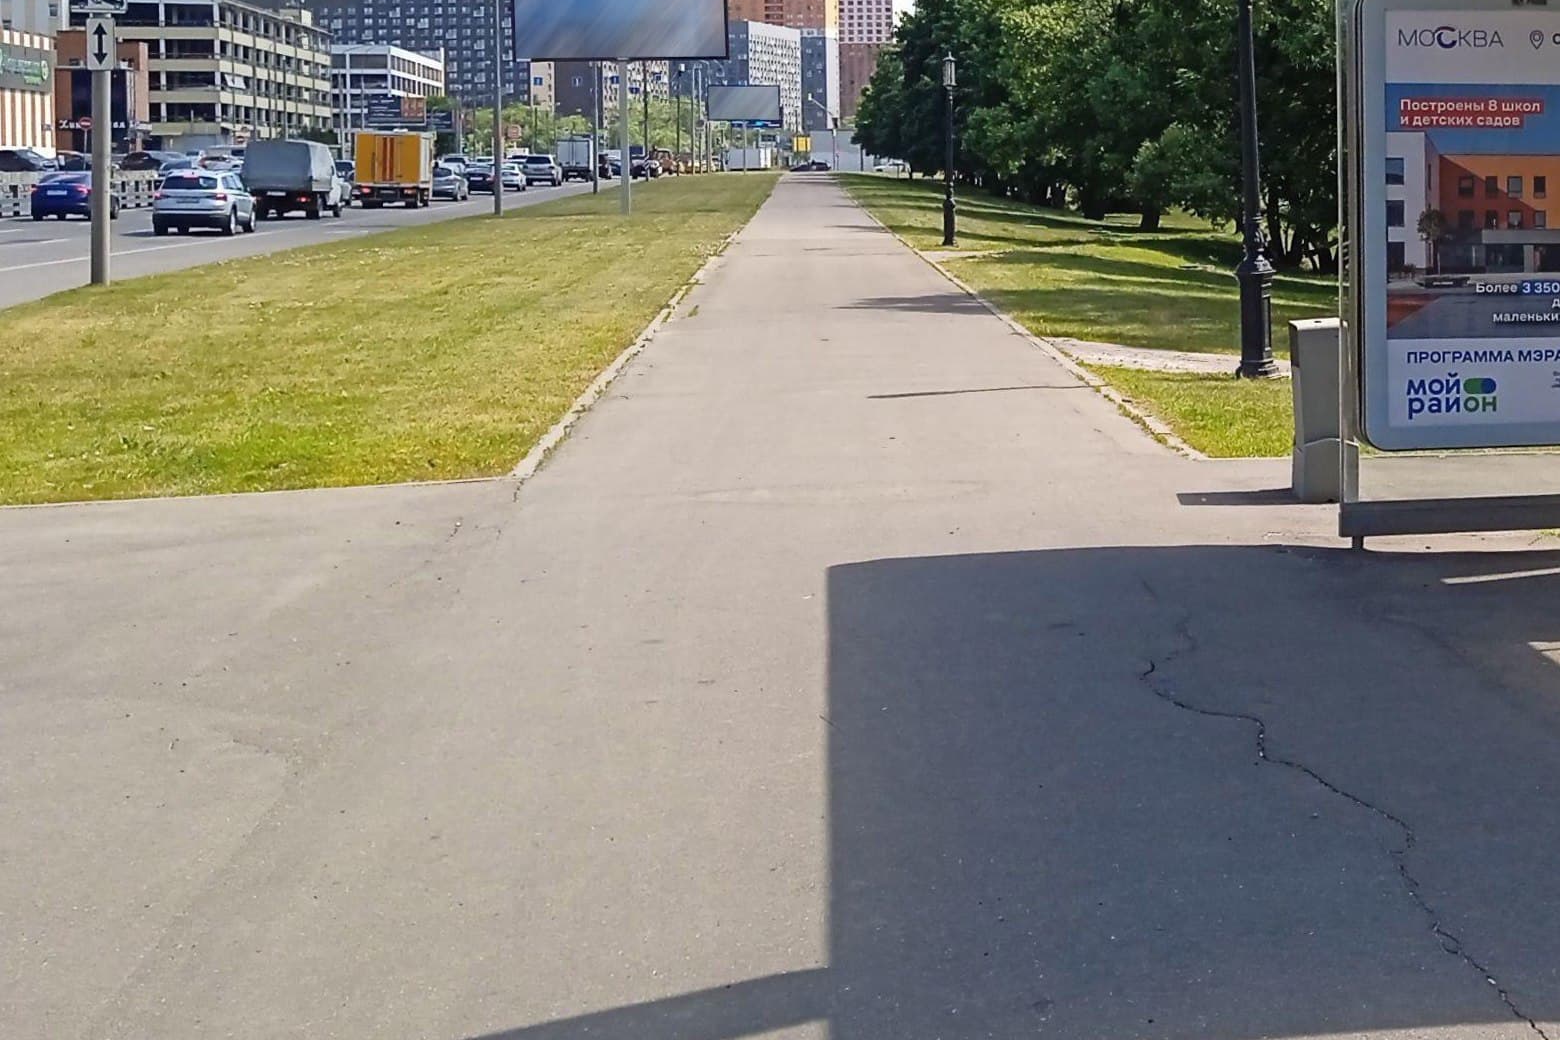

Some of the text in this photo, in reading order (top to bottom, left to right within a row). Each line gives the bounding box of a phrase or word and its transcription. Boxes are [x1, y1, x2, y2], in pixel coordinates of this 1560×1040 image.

[1398, 26, 1504, 49] МОСКВА
[1400, 99, 1541, 115] Построены 8 школ
[1400, 115, 1520, 128] и детских садов
[1476, 282, 1518, 293] Более
[1407, 350, 1514, 364] ПРОГРАММА
[1406, 372, 1460, 396] мой
